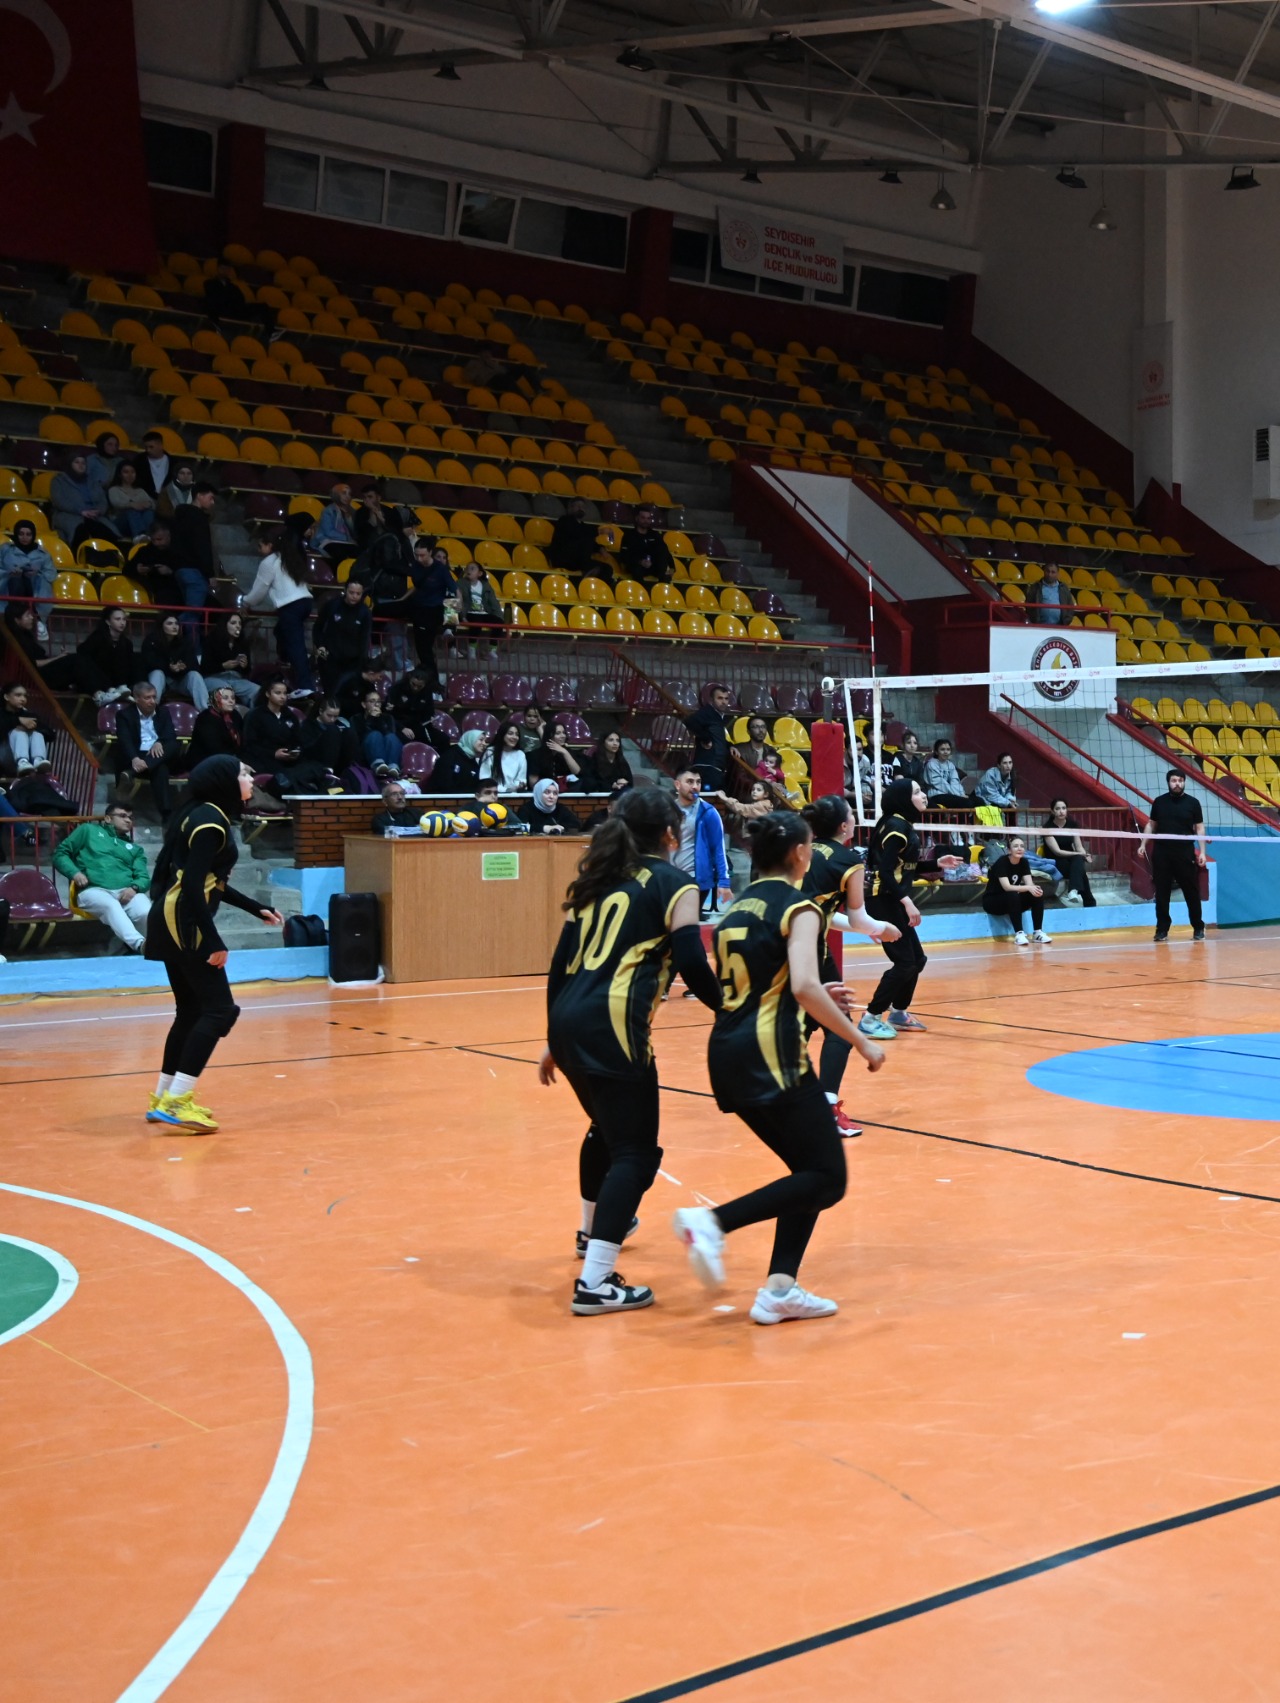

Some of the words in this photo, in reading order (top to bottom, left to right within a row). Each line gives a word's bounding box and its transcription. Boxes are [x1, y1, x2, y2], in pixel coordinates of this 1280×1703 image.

[814, 254, 836, 269] SPOR
[1011, 874, 1019, 885] 9
[565, 891, 630, 975] 10
[719, 926, 751, 1012] 5
